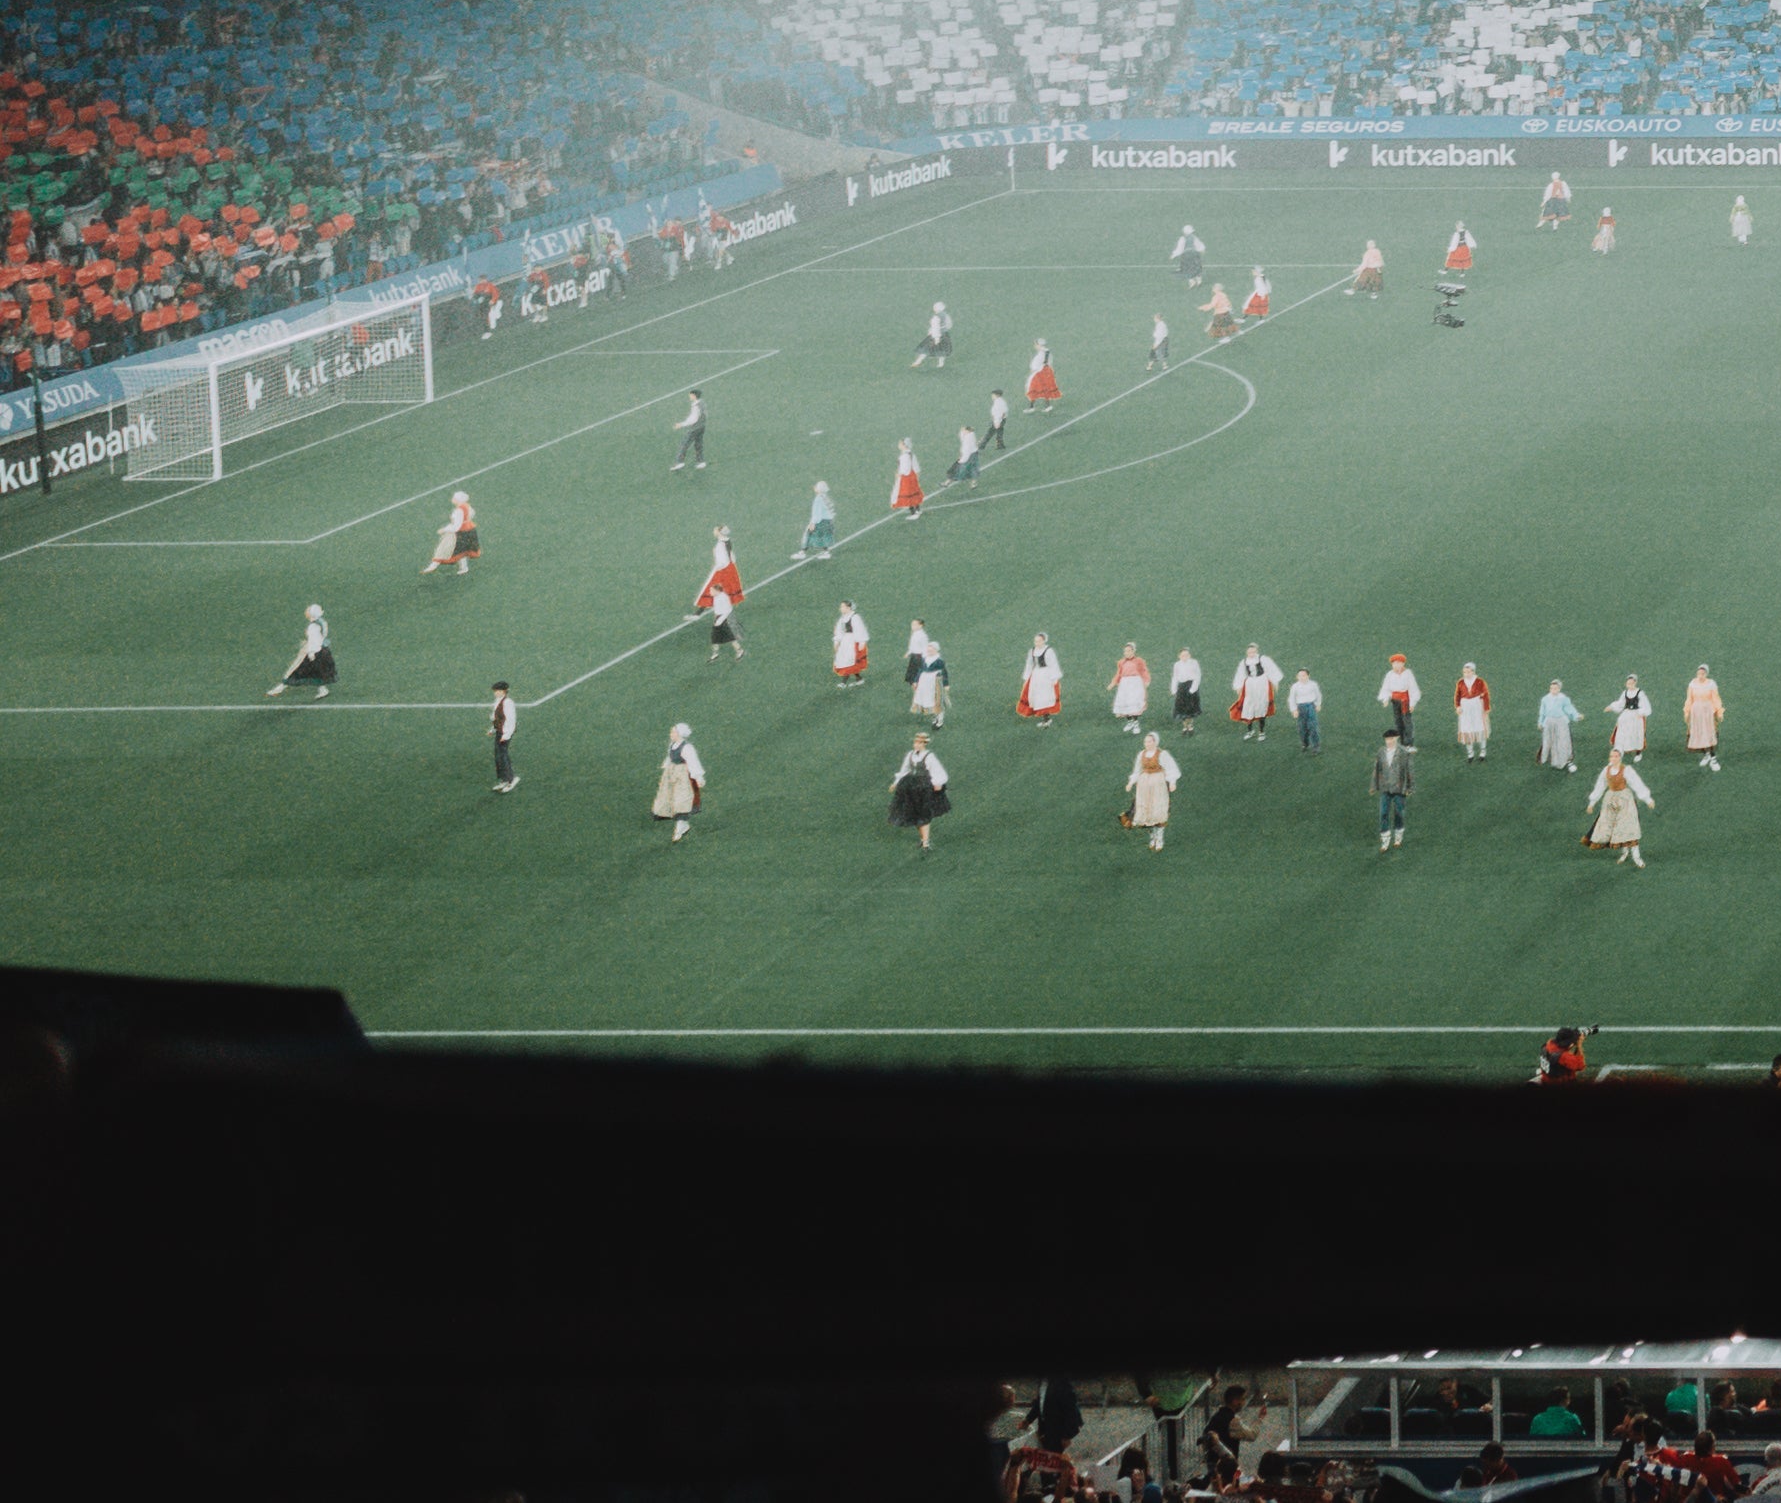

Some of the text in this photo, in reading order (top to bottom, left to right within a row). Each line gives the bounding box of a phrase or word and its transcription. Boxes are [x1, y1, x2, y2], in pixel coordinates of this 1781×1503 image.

[938, 123, 1092, 151] KELER
[1224, 119, 1406, 134] REALE SEGUROS
[1554, 117, 1683, 133] EUSKOAUTO
[1091, 144, 1237, 169] kutxabank
[1370, 143, 1516, 167] kutxabank
[869, 155, 952, 198] kutxabank
[15, 379, 101, 420] YSUDA
[0, 412, 158, 494] kuxabank
